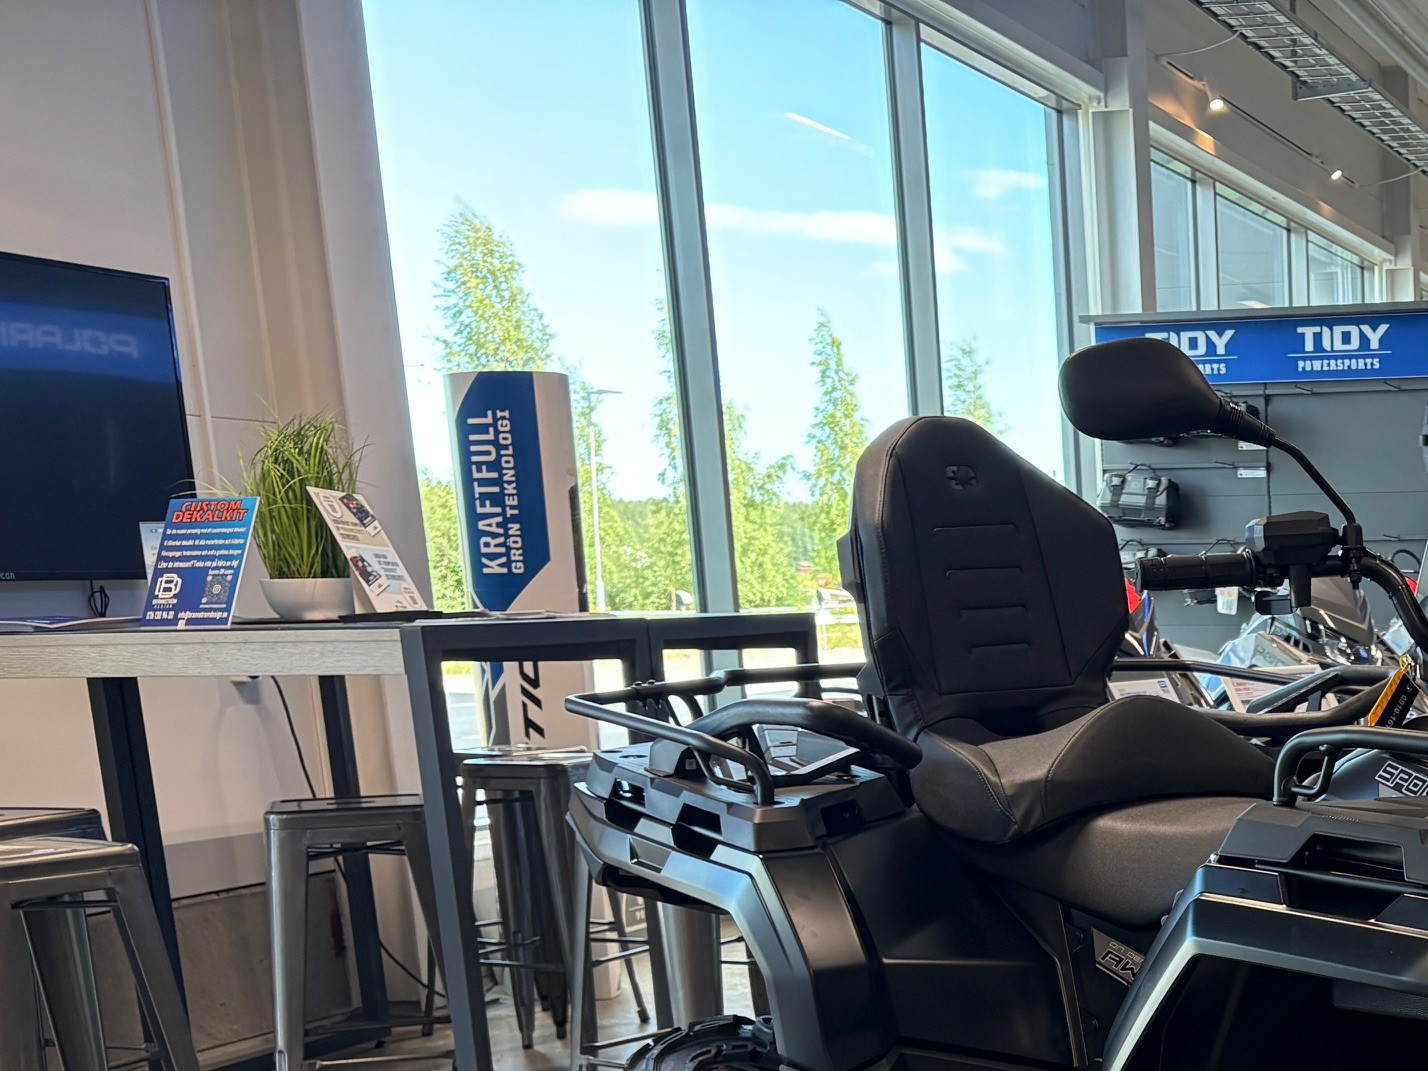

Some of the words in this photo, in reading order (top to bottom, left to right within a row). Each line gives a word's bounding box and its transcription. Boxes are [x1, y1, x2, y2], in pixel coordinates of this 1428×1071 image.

[1297, 324, 1390, 352] TIDY
[1297, 358, 1380, 372] POWERSPORTS
[497, 409, 520, 518] TEKNOLOGI
[181, 500, 242, 512] CUSTOM
[466, 409, 508, 575] KRAFTFULL
[172, 509, 248, 523] DEKALKIT
[511, 525, 525, 574] GRÖN
